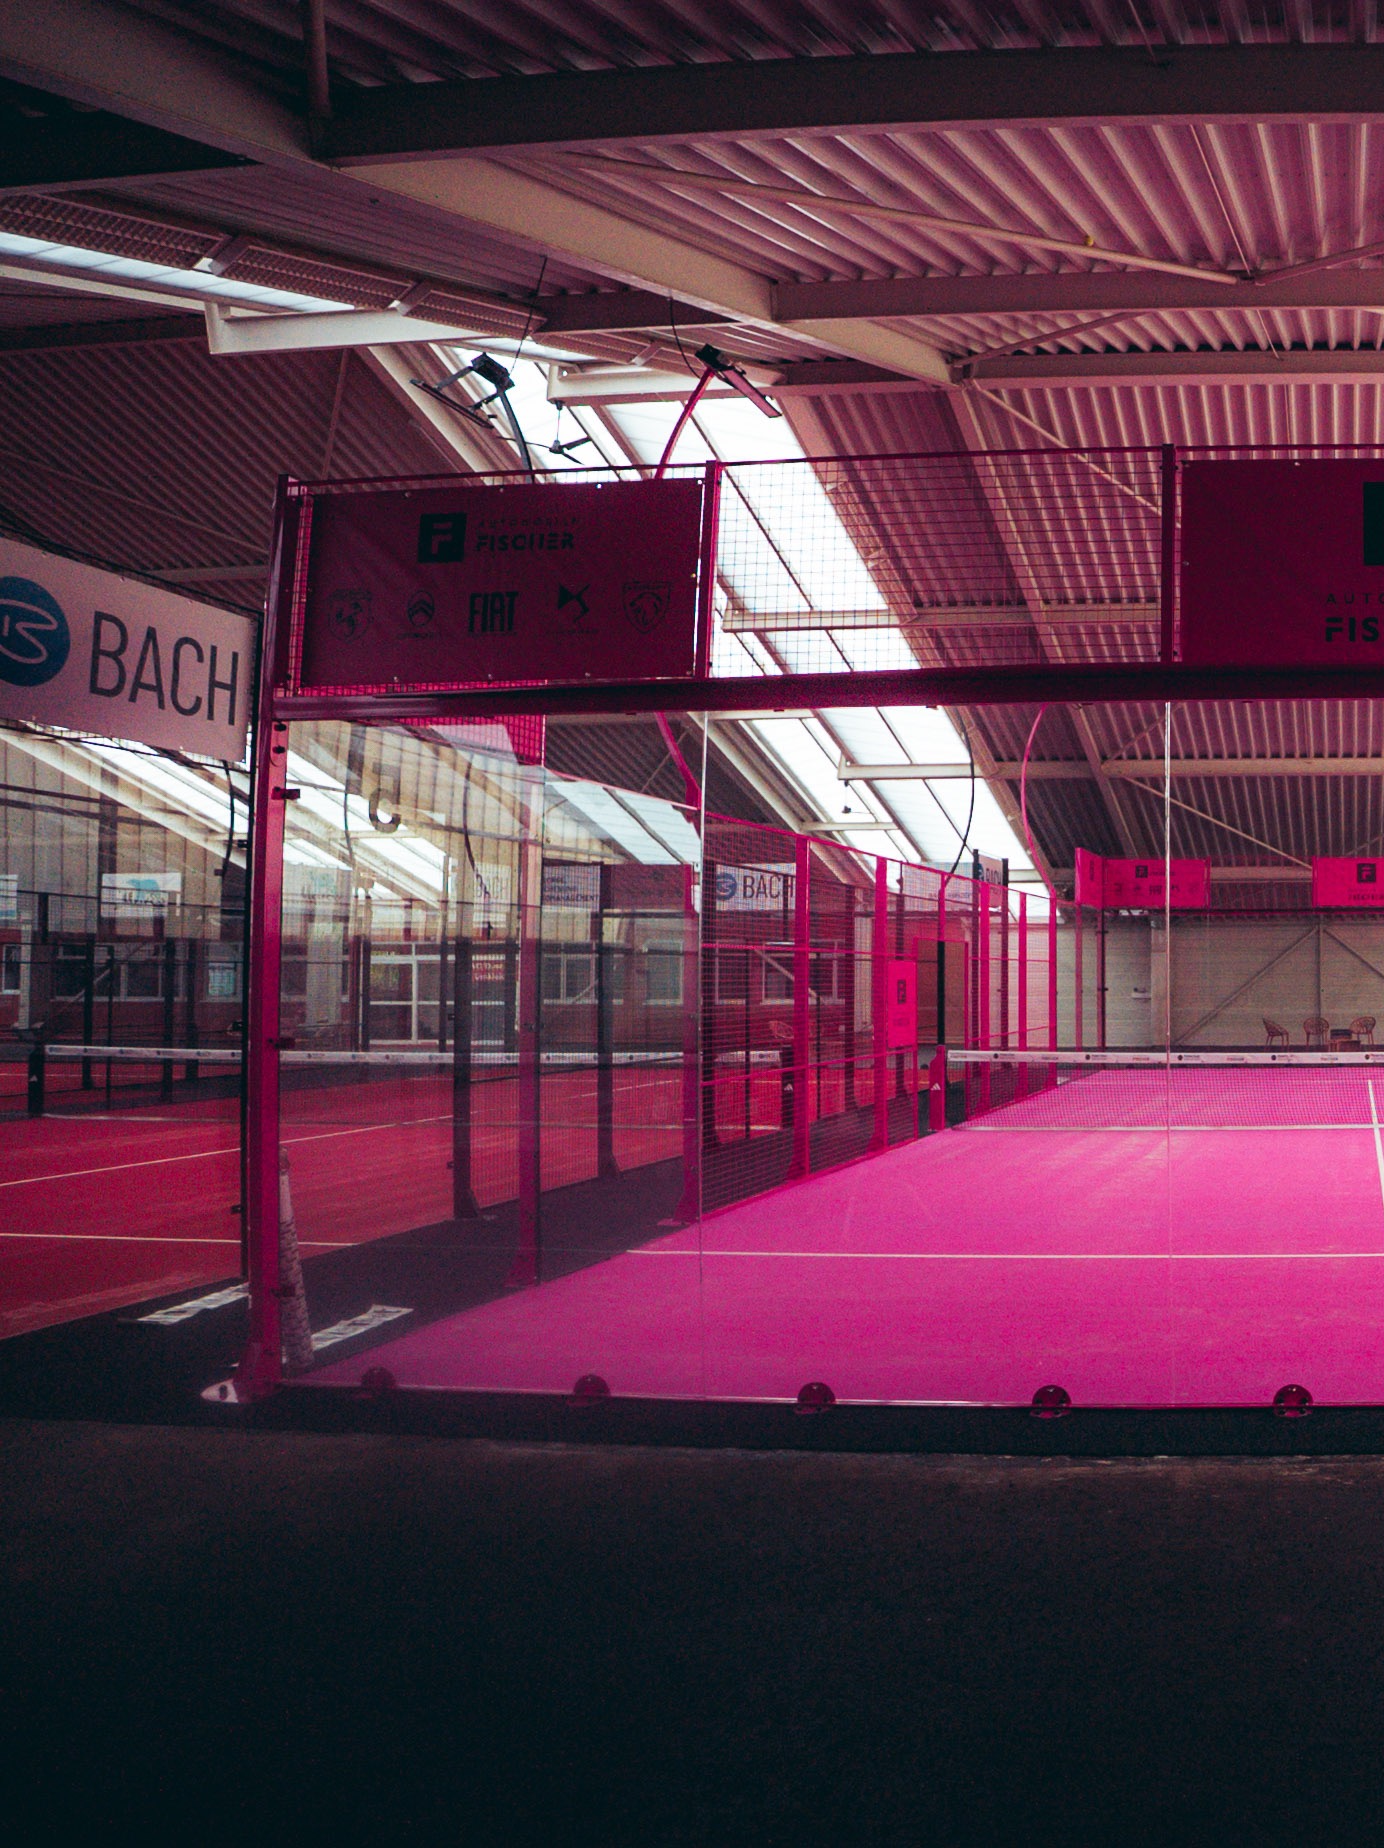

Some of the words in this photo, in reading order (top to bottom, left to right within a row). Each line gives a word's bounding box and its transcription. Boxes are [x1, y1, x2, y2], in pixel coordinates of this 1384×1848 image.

[475, 532, 575, 552] FISCHER
[469, 591, 519, 632] FIAT
[89, 610, 239, 727] BACH
[743, 874, 794, 899] BACH
